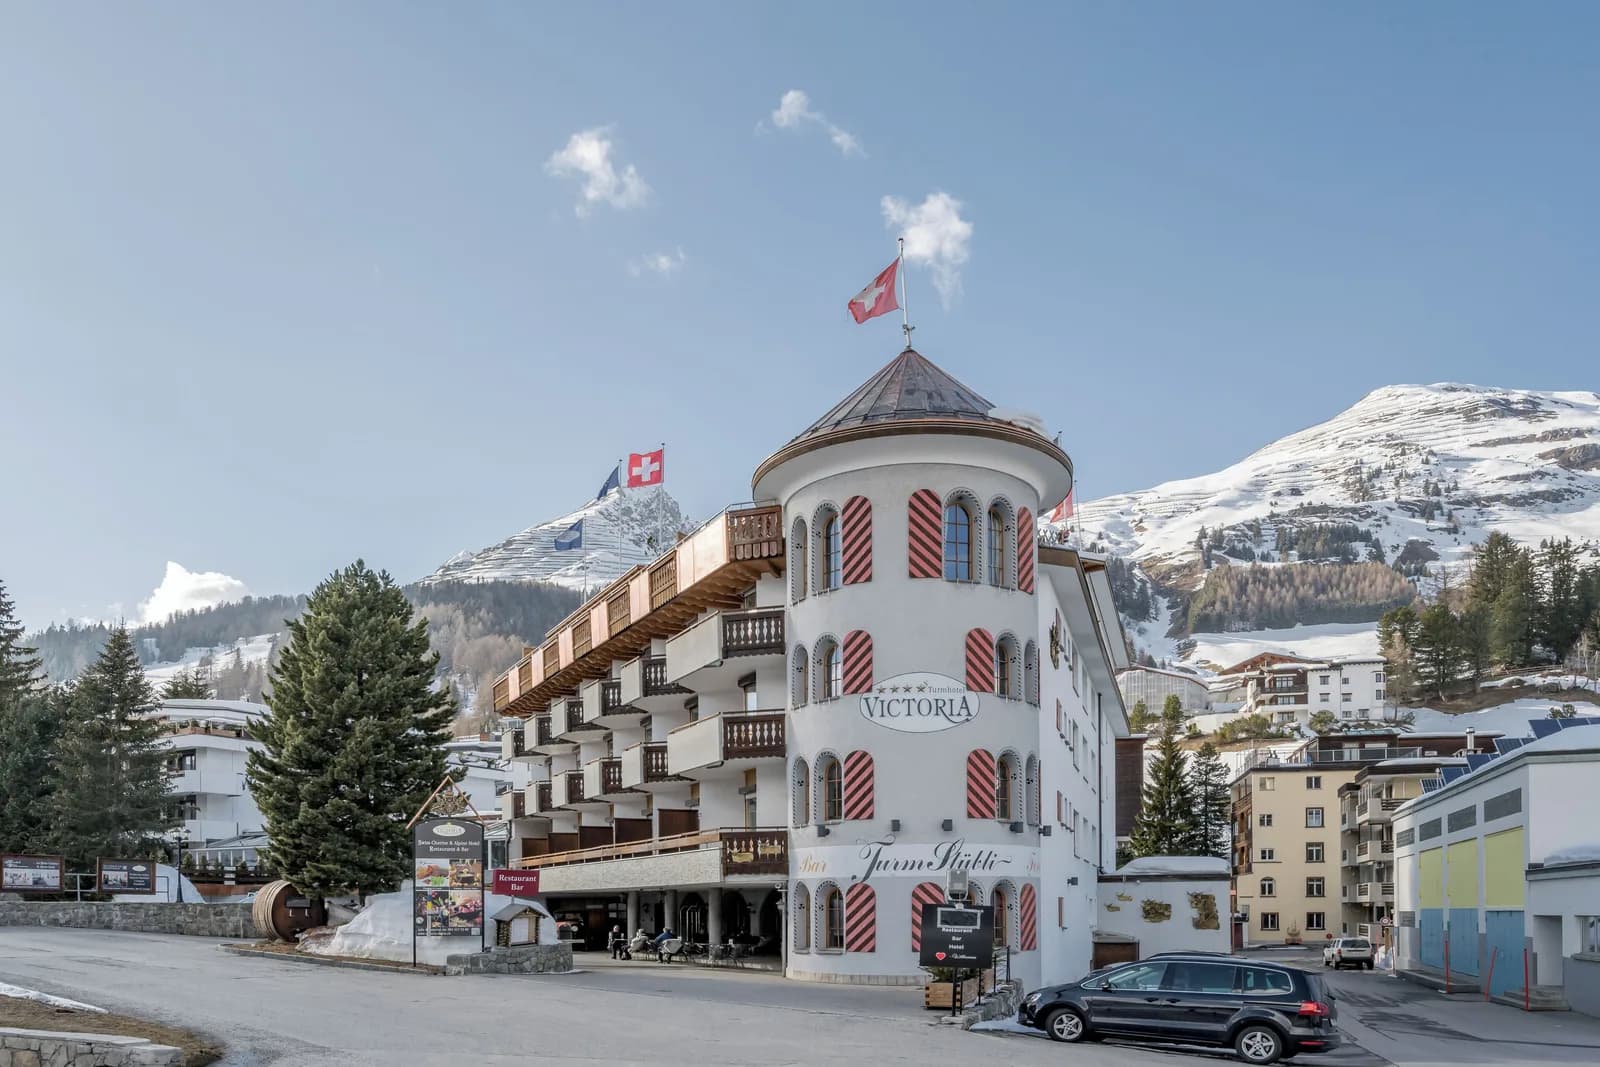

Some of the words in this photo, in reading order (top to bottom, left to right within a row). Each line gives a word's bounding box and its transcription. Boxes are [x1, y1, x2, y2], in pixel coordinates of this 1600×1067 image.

[929, 686, 966, 694] Turmhotel
[863, 696, 973, 724] VICTORIA
[499, 874, 537, 882] Restaurant
